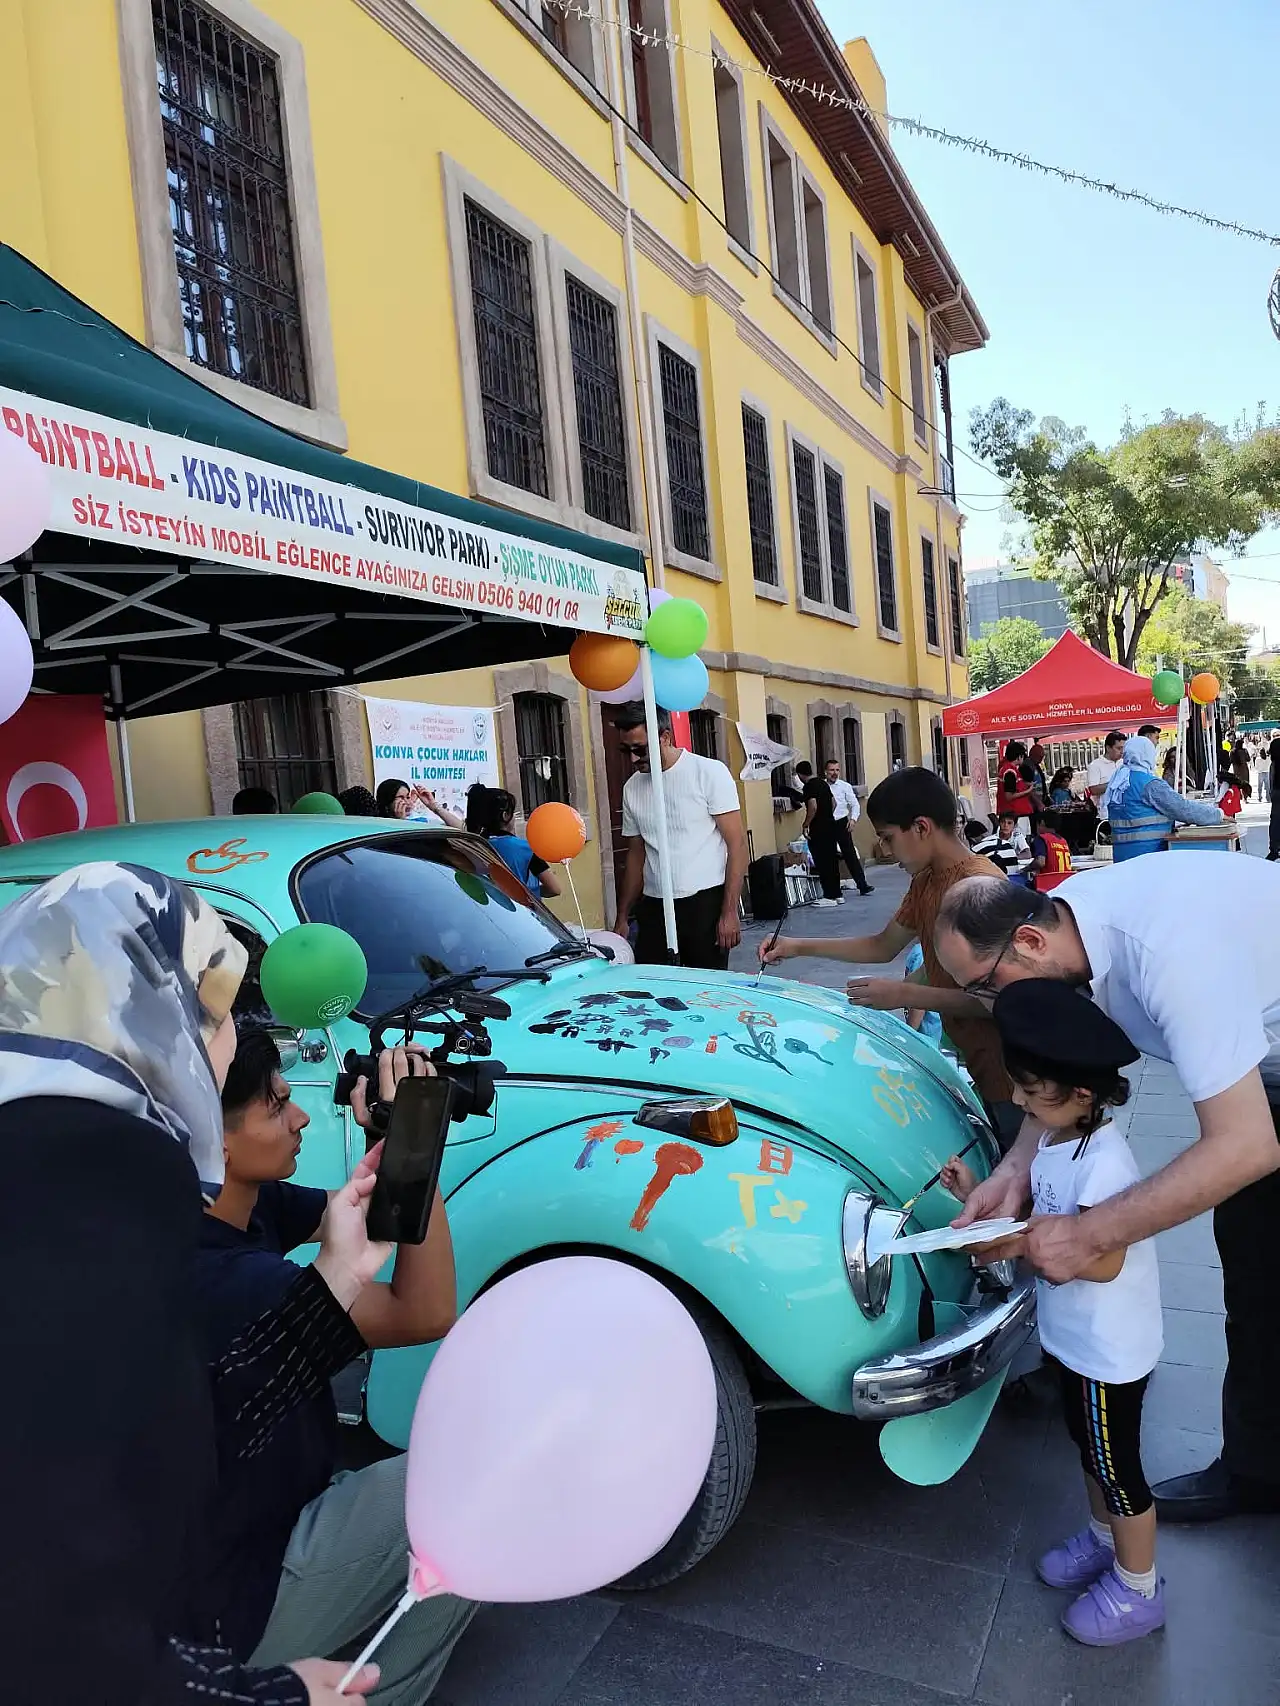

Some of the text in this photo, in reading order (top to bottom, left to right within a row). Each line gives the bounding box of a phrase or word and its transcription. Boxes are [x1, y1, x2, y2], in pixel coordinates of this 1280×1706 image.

[182, 455, 241, 509] KIDS
[448, 528, 489, 569] PARKI
[539, 558, 568, 588] OYUN
[571, 565, 600, 597] PARKI
[72, 494, 579, 621] SİZ İSTEYİN MOBİL EĞLENCE AYAĞINIZA GELSİN 0506 940 01 08
[1007, 715, 1017, 723] VE
[1018, 713, 1045, 721] SOSYAL
[1046, 708, 1086, 718] HİZMETLER
[1087, 706, 1094, 715] İL
[1095, 703, 1142, 714] MÜDÜRLÜĞÜ
[1049, 703, 1074, 711] KONYA
[375, 745, 488, 762] KONYA ÇOCUK HAKLARI
[411, 766, 421, 780] İL
